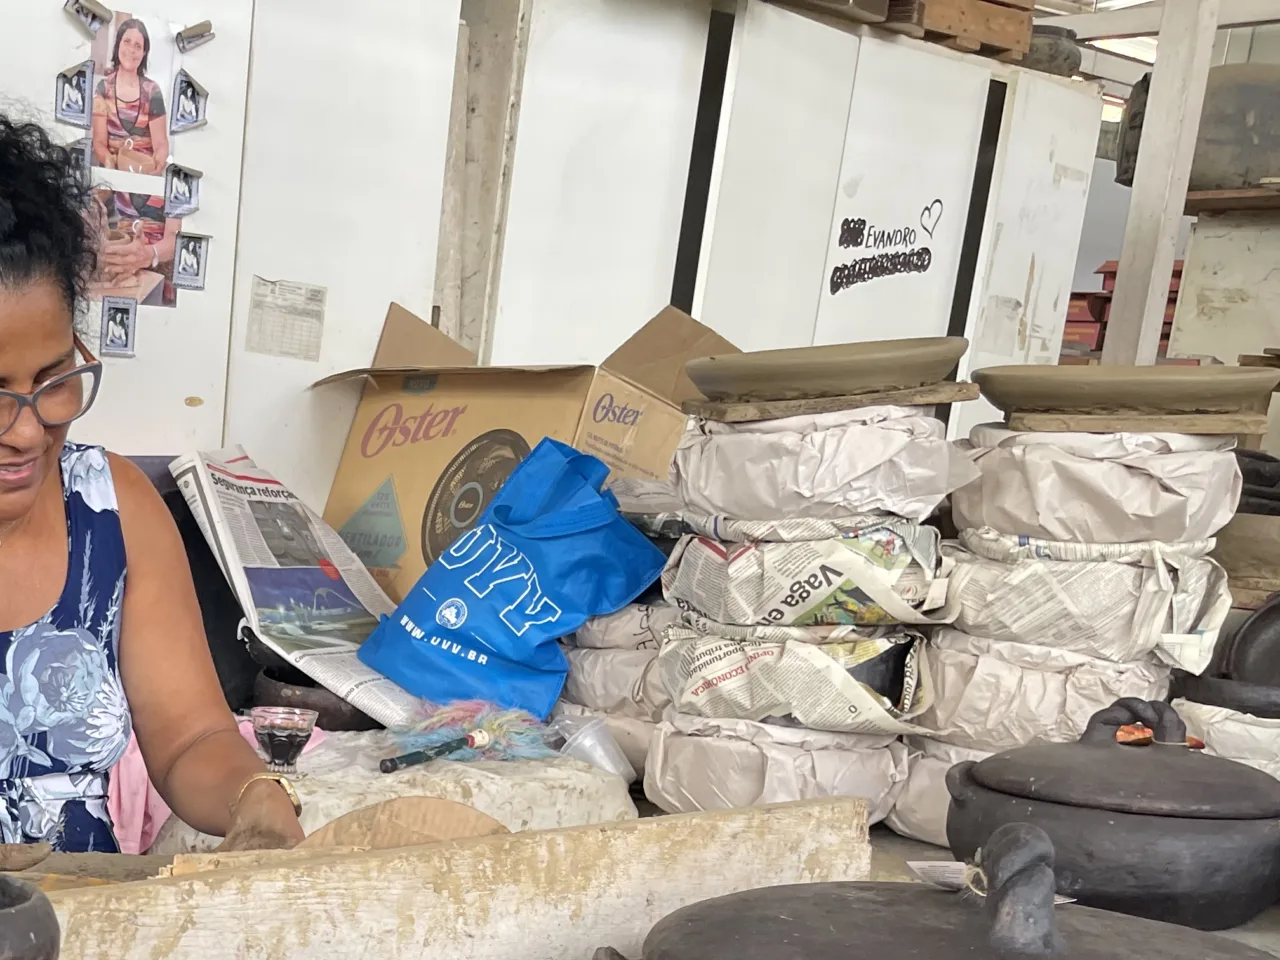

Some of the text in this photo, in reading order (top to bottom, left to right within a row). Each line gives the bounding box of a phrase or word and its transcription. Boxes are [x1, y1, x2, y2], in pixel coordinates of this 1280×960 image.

[865, 225, 917, 250] EVANDRO
[361, 402, 469, 459] Oster
[592, 393, 644, 426] Oster
[211, 472, 257, 499] Segurança
[438, 524, 562, 637] UVV
[781, 564, 844, 607] Vaga
[400, 614, 489, 666] WWW.UVV.BR
